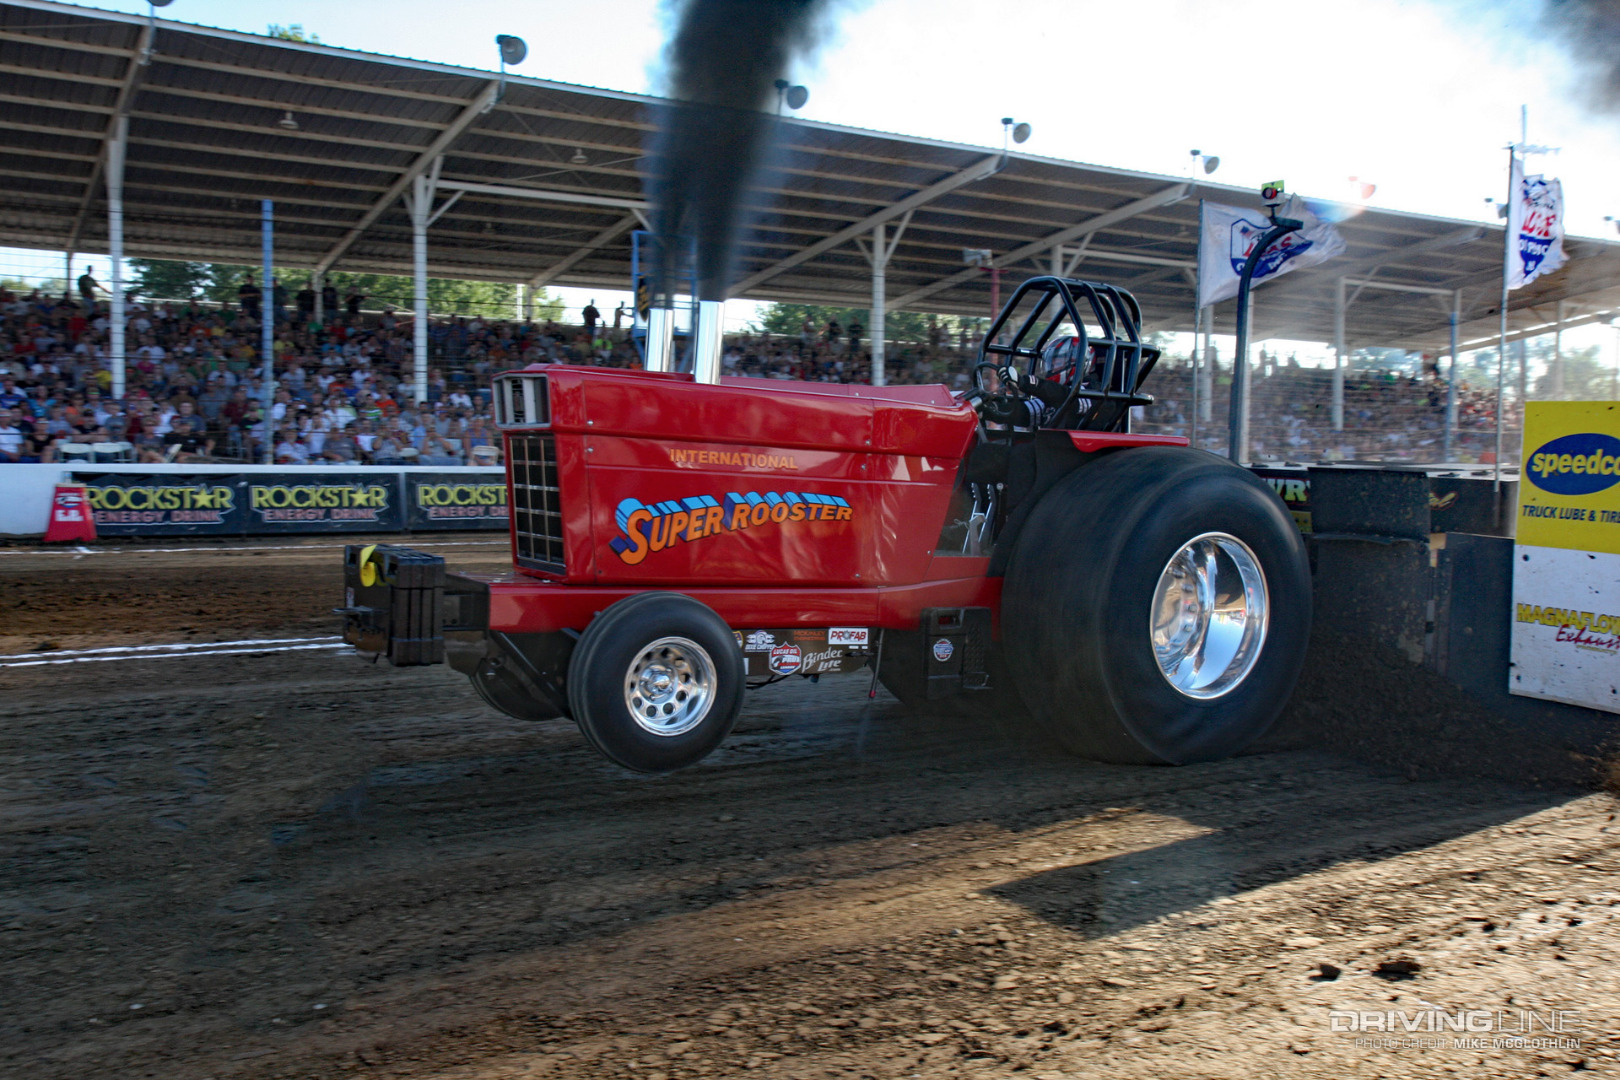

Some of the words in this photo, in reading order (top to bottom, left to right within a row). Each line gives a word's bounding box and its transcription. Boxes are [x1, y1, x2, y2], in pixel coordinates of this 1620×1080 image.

[669, 449, 799, 470] INTERNATIONAL
[418, 485, 508, 506] ROCKST
[96, 510, 166, 522] ENERGY
[171, 510, 221, 522] DRINK
[265, 508, 326, 520] ENERGY
[331, 508, 377, 520] DRINK
[430, 506, 486, 517] ENERGY
[1522, 505, 1558, 518] TRUCK
[1559, 507, 1587, 521] LUBE
[1588, 510, 1596, 521] &
[608, 494, 725, 565] SUPER
[724, 491, 852, 531] ROOSTER
[801, 646, 844, 673] Binder
